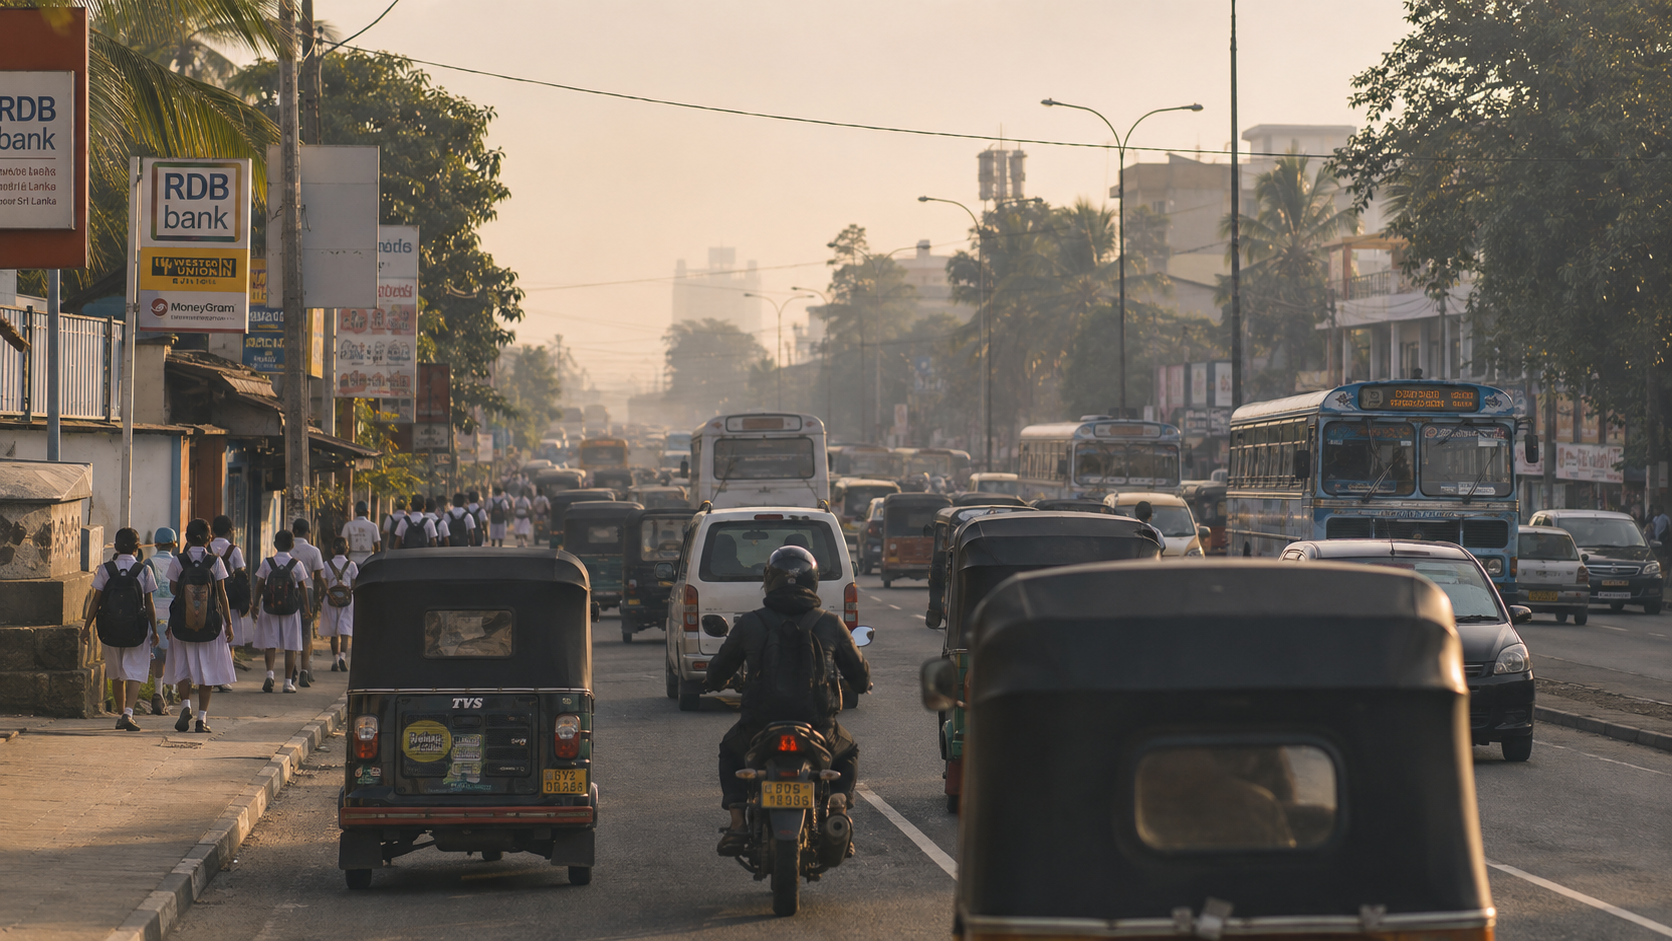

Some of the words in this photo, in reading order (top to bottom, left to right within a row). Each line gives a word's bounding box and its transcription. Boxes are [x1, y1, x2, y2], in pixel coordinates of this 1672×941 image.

[0, 96, 56, 121] RDB
[0, 126, 56, 150] bank
[165, 173, 229, 200] RDB
[164, 205, 228, 230] bank
[170, 302, 235, 313] MoneyGram
[452, 697, 483, 709] TVS
